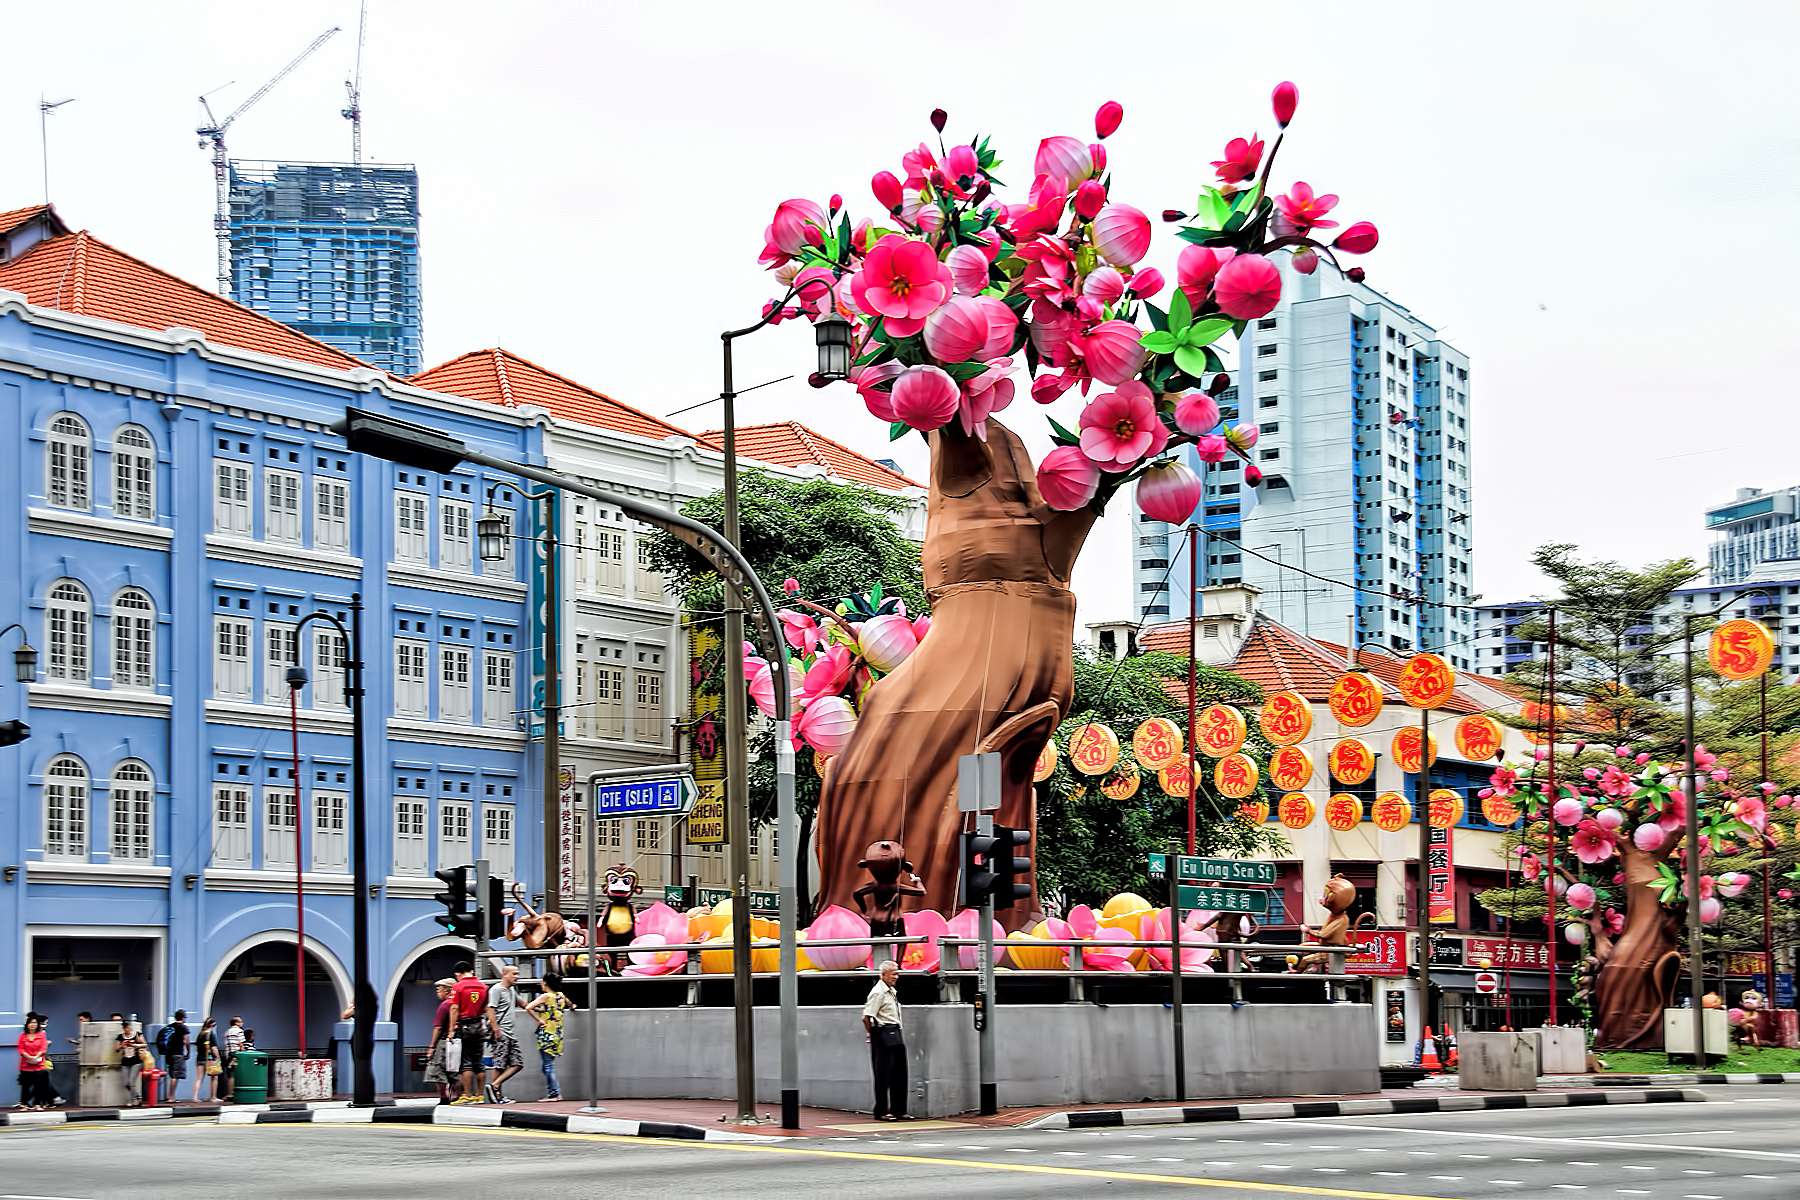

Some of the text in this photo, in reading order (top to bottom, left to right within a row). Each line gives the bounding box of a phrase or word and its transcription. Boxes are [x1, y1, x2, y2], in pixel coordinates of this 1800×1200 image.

[601, 787, 654, 808] CTE (SLE)
[690, 803, 723, 819] CHENG
[690, 823, 722, 837] HIANG
[1182, 859, 1272, 880] Eu Tong Sen St
[701, 890, 727, 904] New
[1495, 943, 1549, 964] 东方美食
